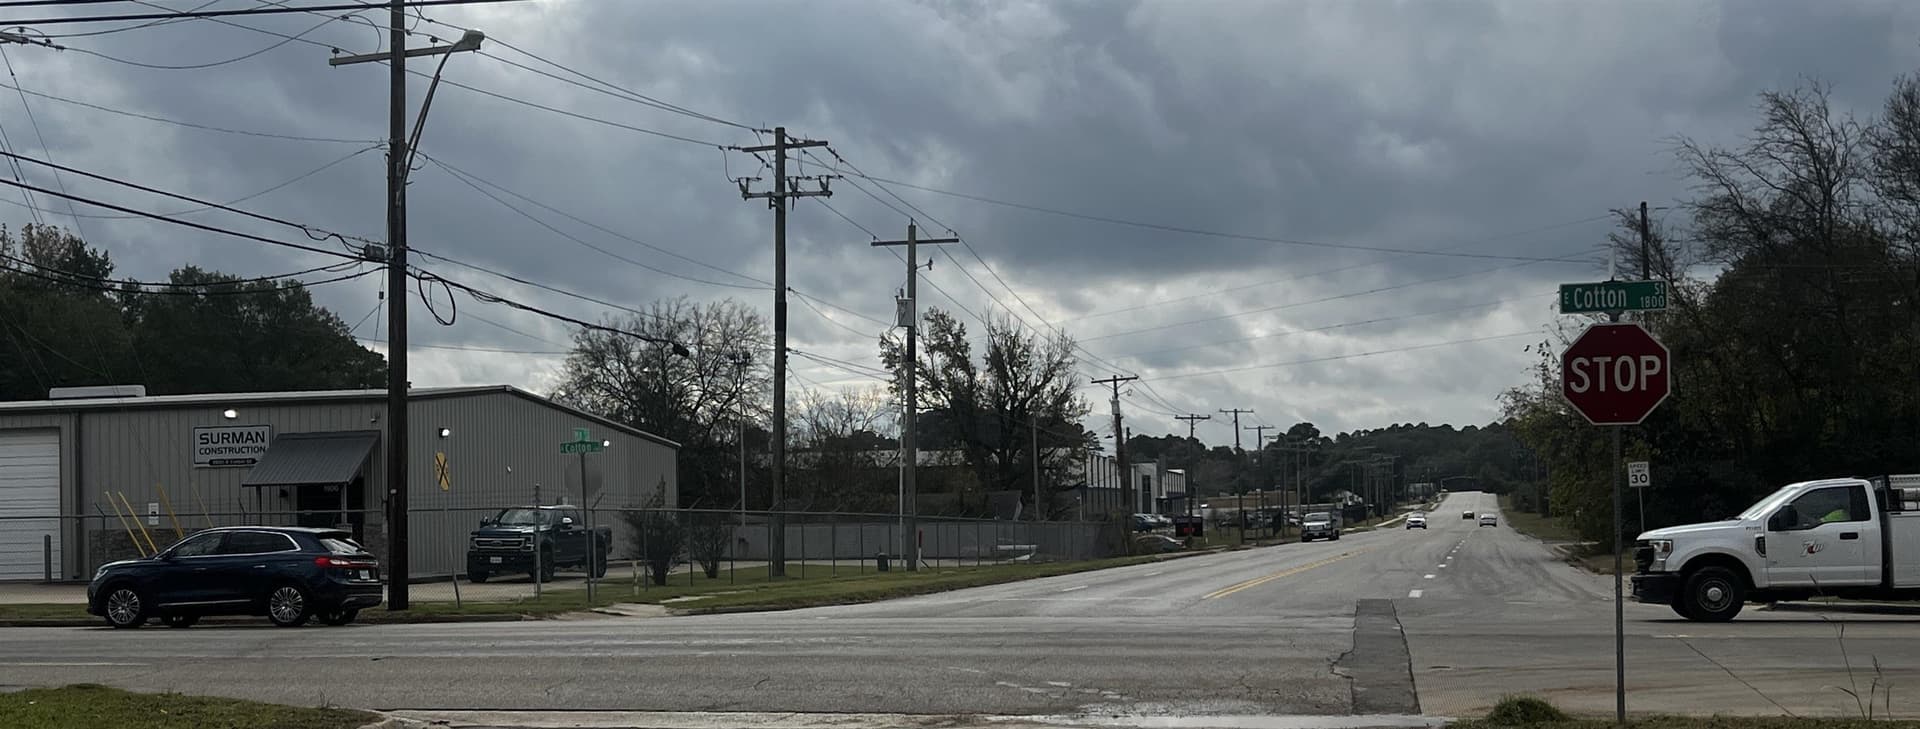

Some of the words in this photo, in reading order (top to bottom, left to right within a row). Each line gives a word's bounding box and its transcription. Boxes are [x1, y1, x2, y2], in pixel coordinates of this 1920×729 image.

[1654, 283, 1665, 295] St
[1564, 292, 1569, 304] E
[1574, 286, 1627, 309] Cotton
[1640, 295, 1665, 308] 1800
[1569, 355, 1662, 393] STOP
[199, 431, 266, 445] SURMAN
[199, 446, 266, 455] CONSTRUCTION
[1631, 473, 1648, 483] 30
